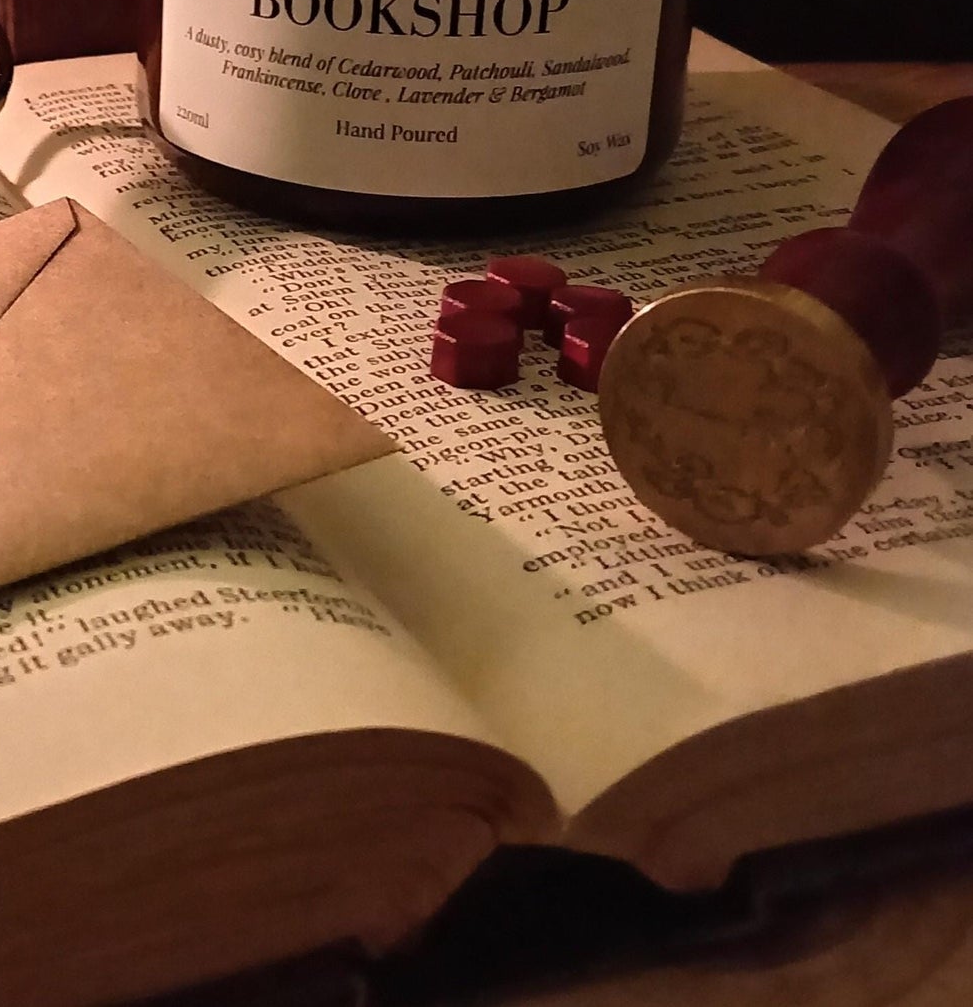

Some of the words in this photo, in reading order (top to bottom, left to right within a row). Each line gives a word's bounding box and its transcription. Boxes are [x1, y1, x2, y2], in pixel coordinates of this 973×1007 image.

[184, 26, 193, 40] A
[234, 43, 265, 62] cosy
[268, 47, 313, 69] blend
[316, 56, 337, 75] of
[338, 57, 442, 81] Cedarwood,
[398, 87, 484, 104] Lavender
[489, 87, 506, 103] &
[511, 81, 587, 104] Bergamot
[176, 105, 210, 129] 220ml
[335, 119, 385, 142] Hand
[391, 123, 458, 144] Poured
[577, 141, 600, 157] Soy
[185, 244, 222, 261] my
[205, 251, 298, 278] thought
[363, 271, 409, 284] you
[374, 287, 437, 301] That
[248, 303, 274, 317] at
[281, 286, 356, 305] Salem
[270, 314, 320, 337] coal
[328, 308, 360, 321] on
[365, 301, 407, 313] the
[591, 268, 646, 286] with
[282, 321, 348, 348] ever?
[379, 309, 429, 325] And
[303, 346, 361, 369] that
[315, 361, 360, 381] the
[326, 376, 362, 394] he
[368, 358, 431, 379] woul
[338, 380, 406, 405] been
[354, 384, 453, 416] During
[370, 393, 488, 428] speaking
[425, 411, 472, 427] the
[477, 398, 549, 415] lump
[559, 390, 583, 402] of
[454, 415, 524, 437] same
[409, 426, 562, 471] pigeon-pie,
[440, 459, 555, 496] starting
[564, 445, 612, 463] out
[456, 493, 489, 511] at
[498, 478, 549, 495] the
[558, 461, 618, 482] tabl
[468, 479, 627, 523] Yarmouth.
[566, 495, 638, 516] thou
[523, 525, 673, 573] employed.
[32, 554, 217, 604] atonement,
[74, 590, 213, 634] laughed
[574, 593, 639, 626] now
[666, 570, 752, 595] think
[56, 627, 138, 668] gaily
[150, 610, 251, 638] away.
